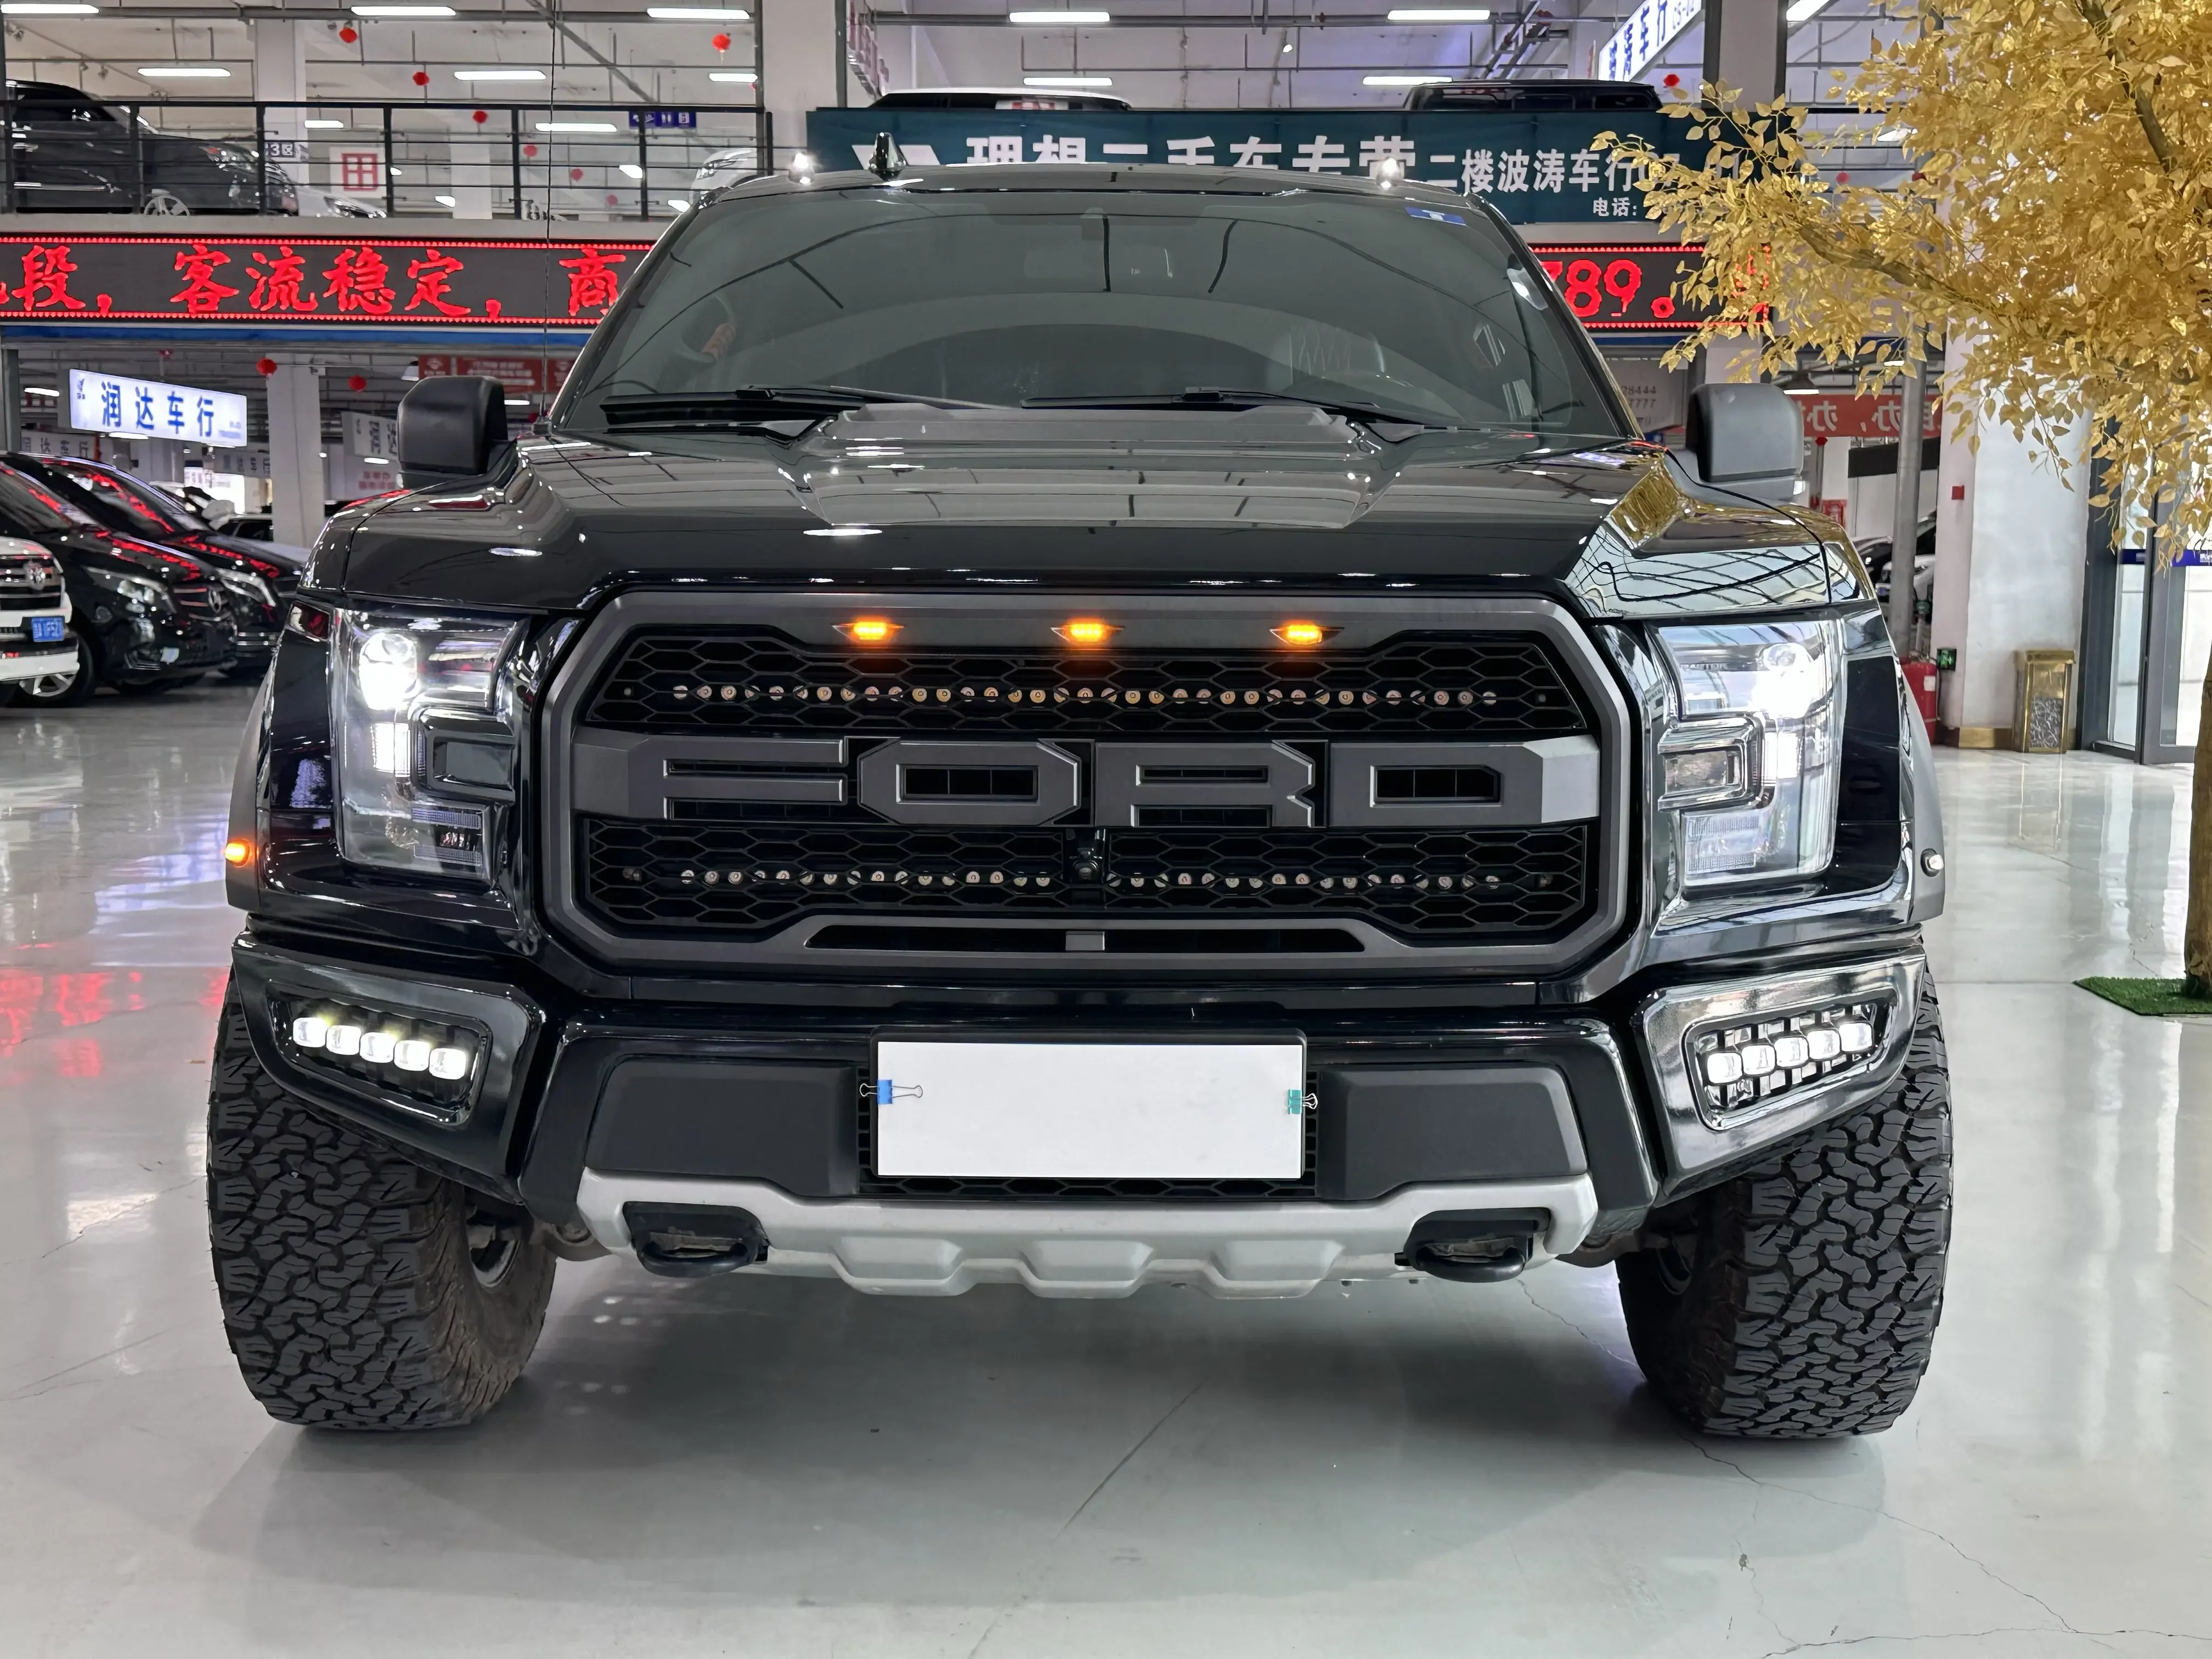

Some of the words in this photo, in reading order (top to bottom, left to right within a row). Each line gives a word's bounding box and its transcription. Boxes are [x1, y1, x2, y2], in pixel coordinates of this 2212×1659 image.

[1427, 149, 1633, 193] 二楼波涛车行
[0, 244, 626, 318] 段，客流稳定，商
[101, 381, 215, 437] 润达车行
[572, 734, 1600, 827] FORD
